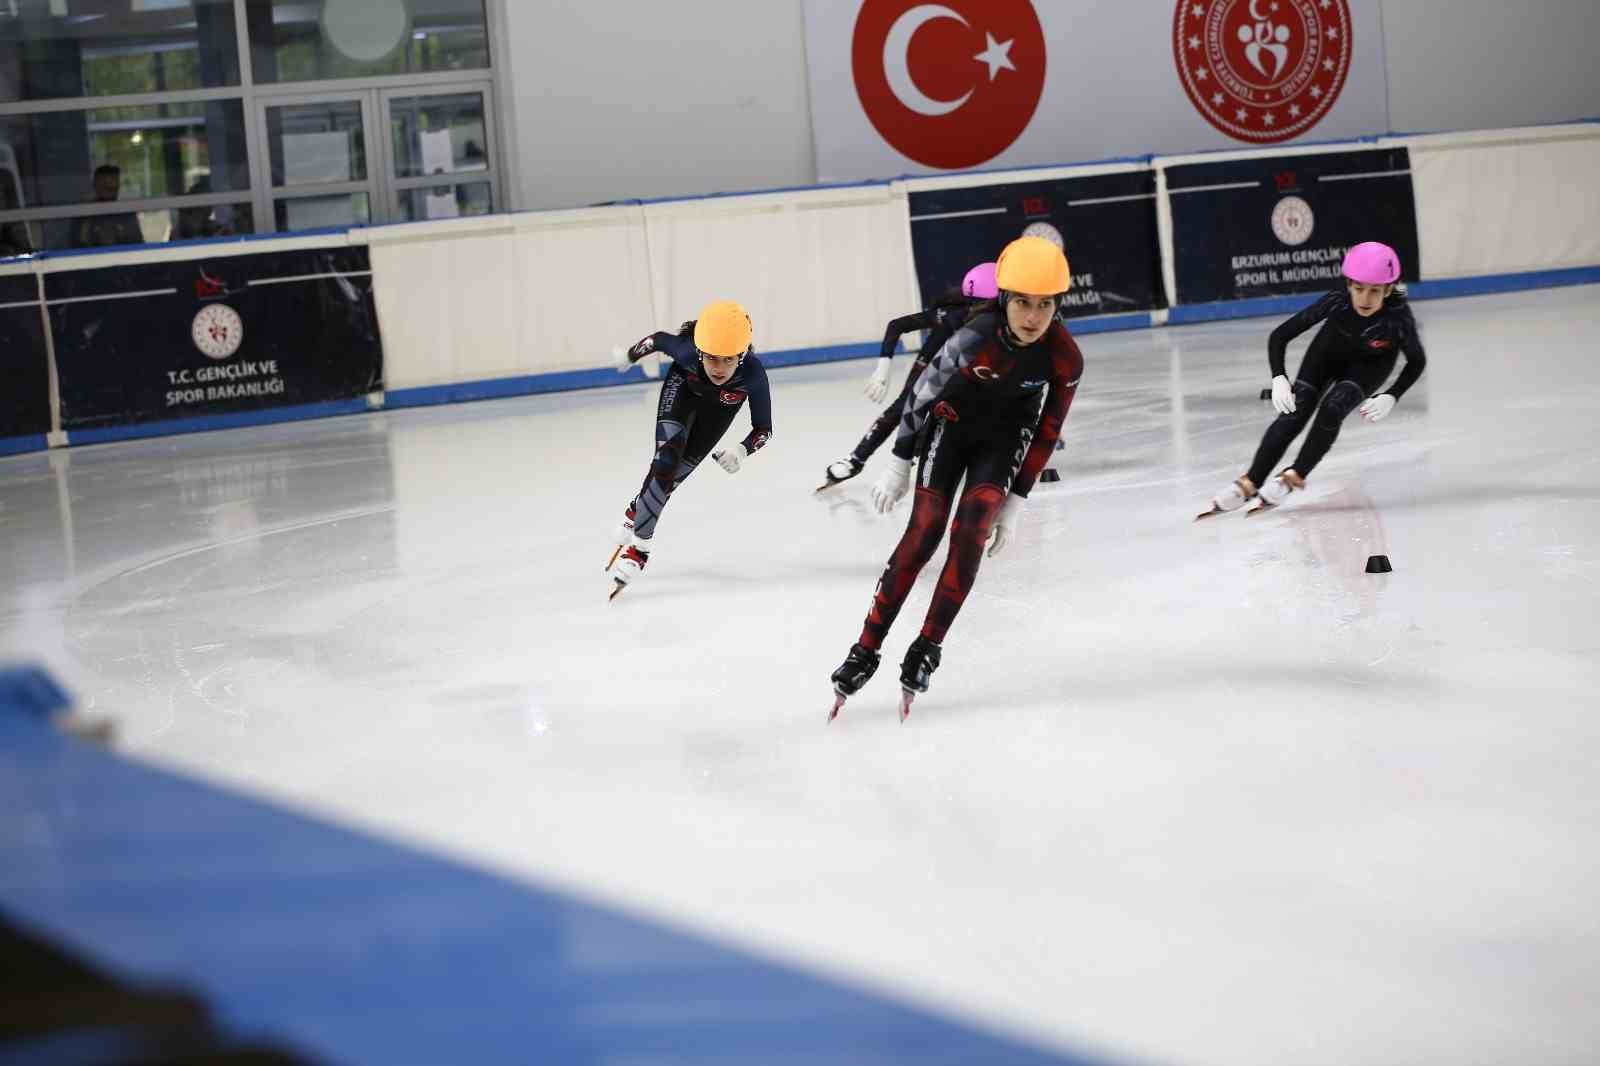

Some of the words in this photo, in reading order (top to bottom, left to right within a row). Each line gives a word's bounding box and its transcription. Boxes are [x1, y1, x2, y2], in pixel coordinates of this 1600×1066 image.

[1231, 253, 1291, 269] ERZURUM
[1291, 247, 1341, 264] GENÇLİK
[1076, 273, 1095, 287] VE
[1234, 272, 1267, 287] SPOR
[1268, 268, 1281, 284] İL
[1282, 262, 1341, 281] MÜDÜRLÜ
[1060, 289, 1101, 307] ANLIĞI
[167, 369, 195, 384] T.C.
[196, 360, 258, 382] GENÇLİK
[259, 360, 279, 374] VE
[166, 387, 205, 407] SPOR
[207, 377, 285, 401] BAKANLIĞI
